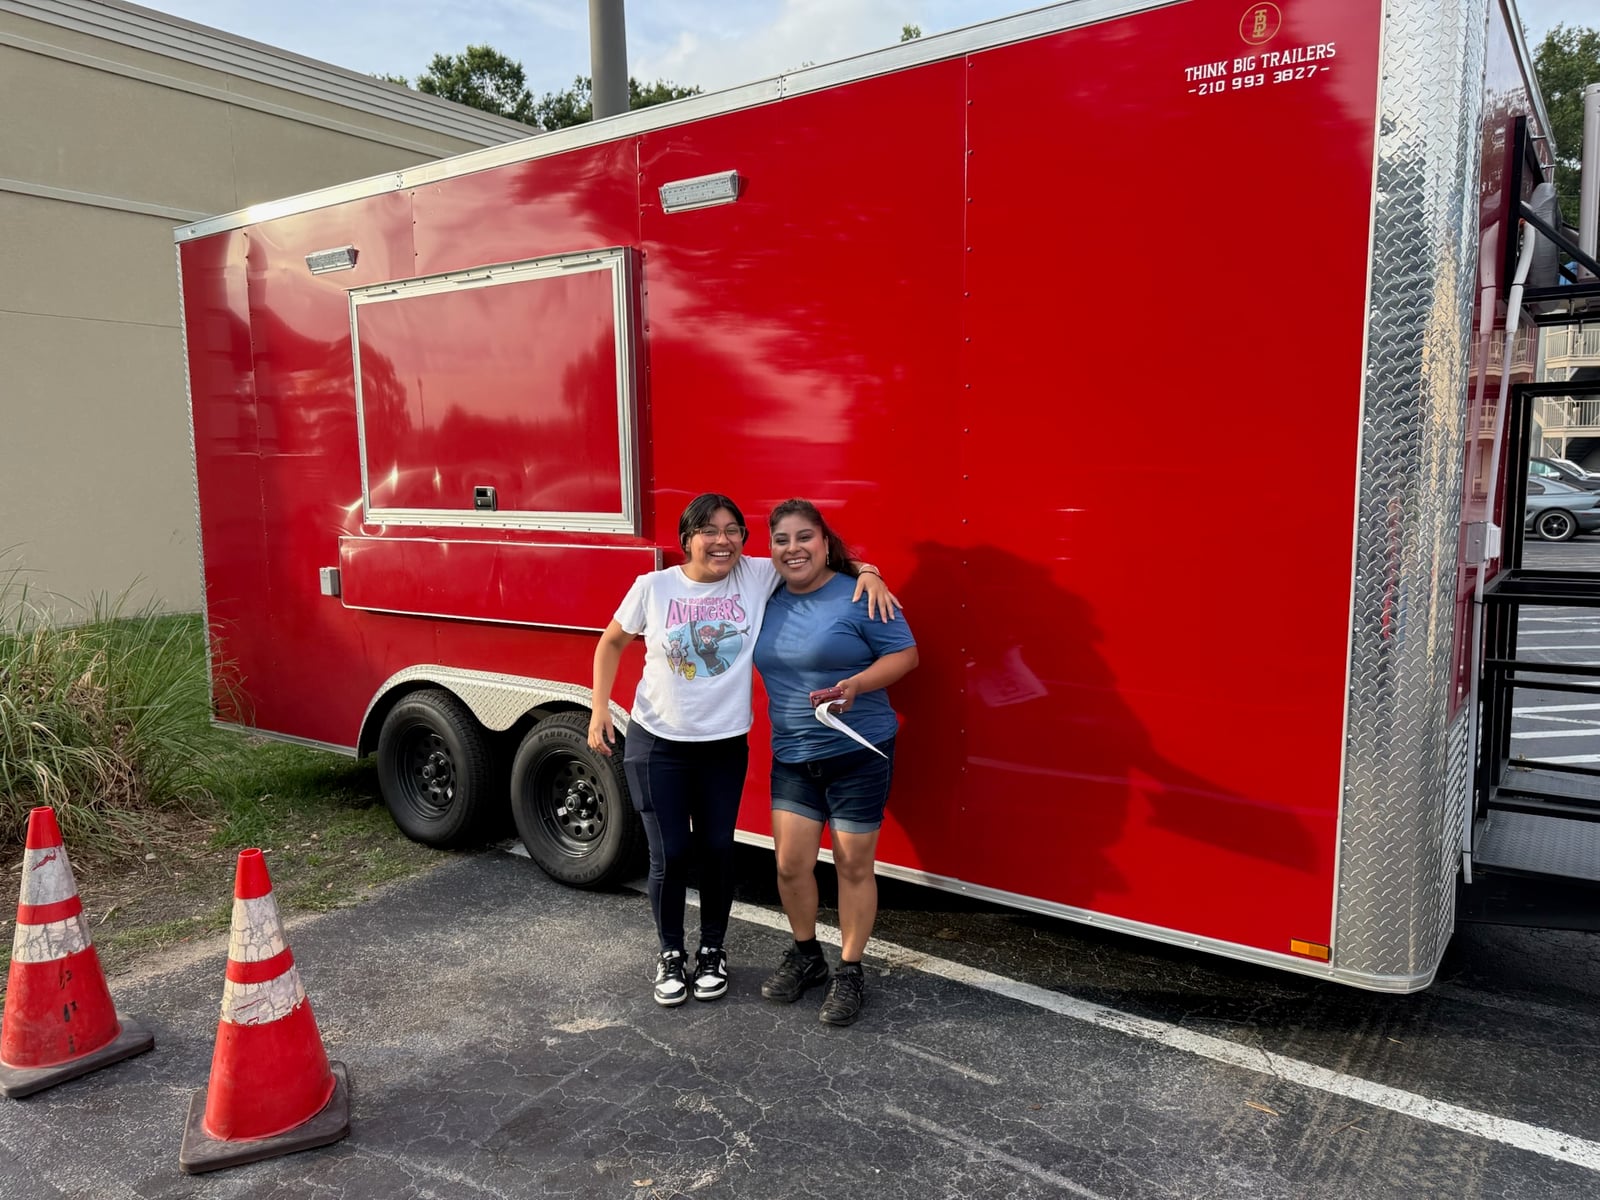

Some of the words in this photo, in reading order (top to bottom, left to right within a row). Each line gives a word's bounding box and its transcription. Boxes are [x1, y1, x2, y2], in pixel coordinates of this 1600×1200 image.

[1184, 60, 1228, 82] THINK
[1233, 56, 1256, 74] BIG
[1260, 42, 1336, 69] TRAILERS
[1231, 73, 1265, 90] 993
[665, 593, 746, 629] AVENGERS
